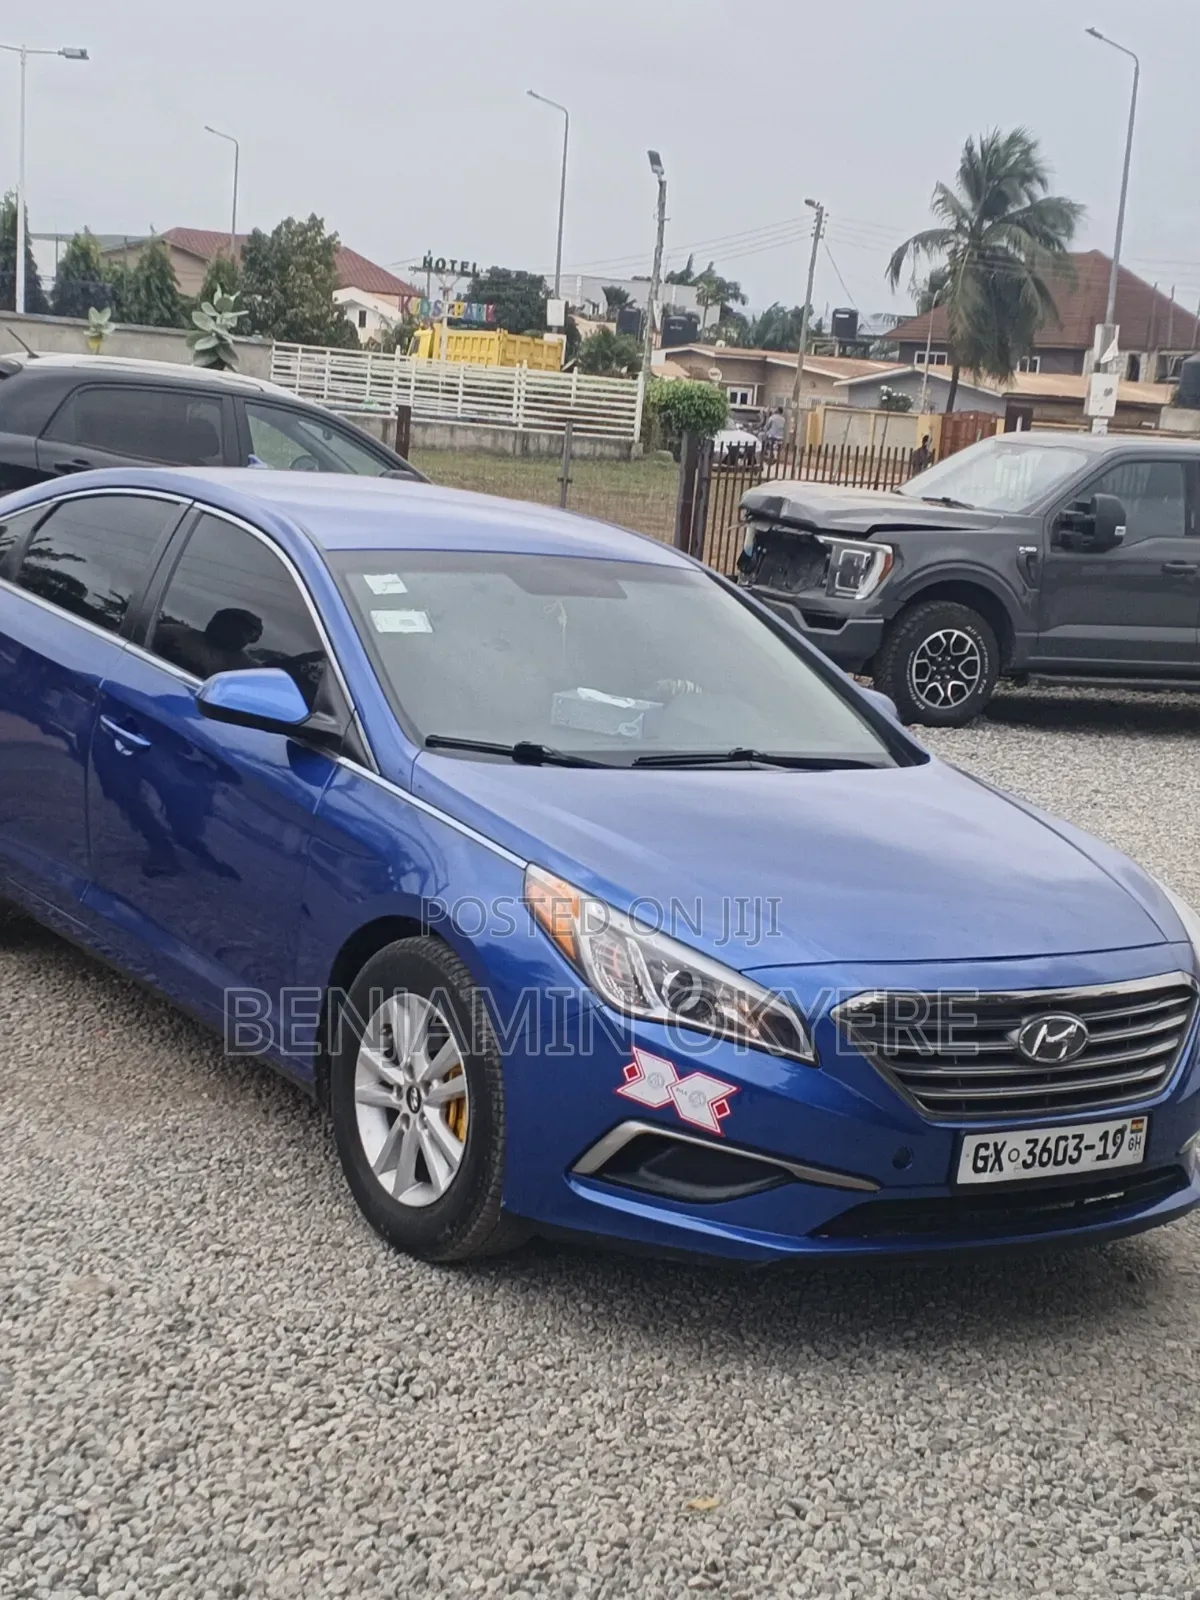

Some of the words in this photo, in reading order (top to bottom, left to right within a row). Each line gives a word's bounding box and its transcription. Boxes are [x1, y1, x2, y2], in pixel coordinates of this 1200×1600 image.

[422, 255, 479, 276] HOTEL
[454, 301, 497, 322] PARK
[972, 1141, 1006, 1174] GX
[1022, 1126, 1127, 1170] 3603-19
[1128, 1134, 1142, 1151] GH
